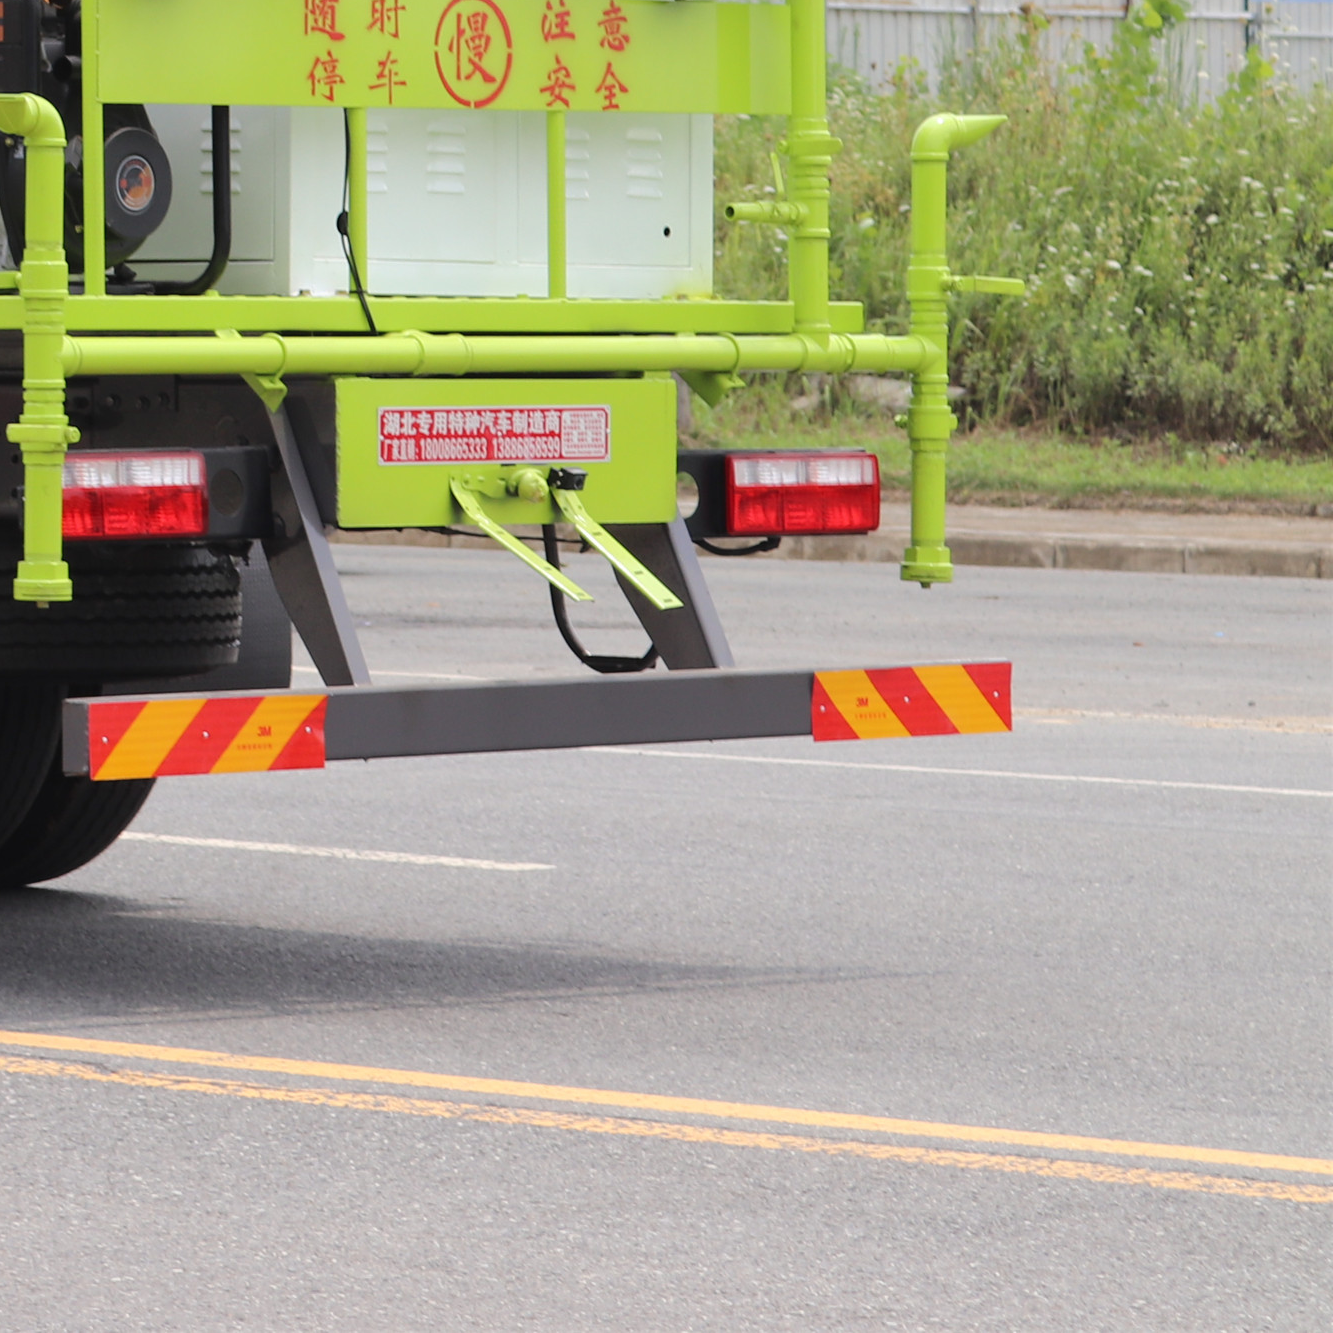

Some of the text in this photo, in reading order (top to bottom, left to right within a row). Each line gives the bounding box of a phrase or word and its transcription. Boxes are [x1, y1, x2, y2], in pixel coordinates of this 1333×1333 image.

[305, 48, 630, 112] 停车 安全
[447, 11, 498, 86] 慢
